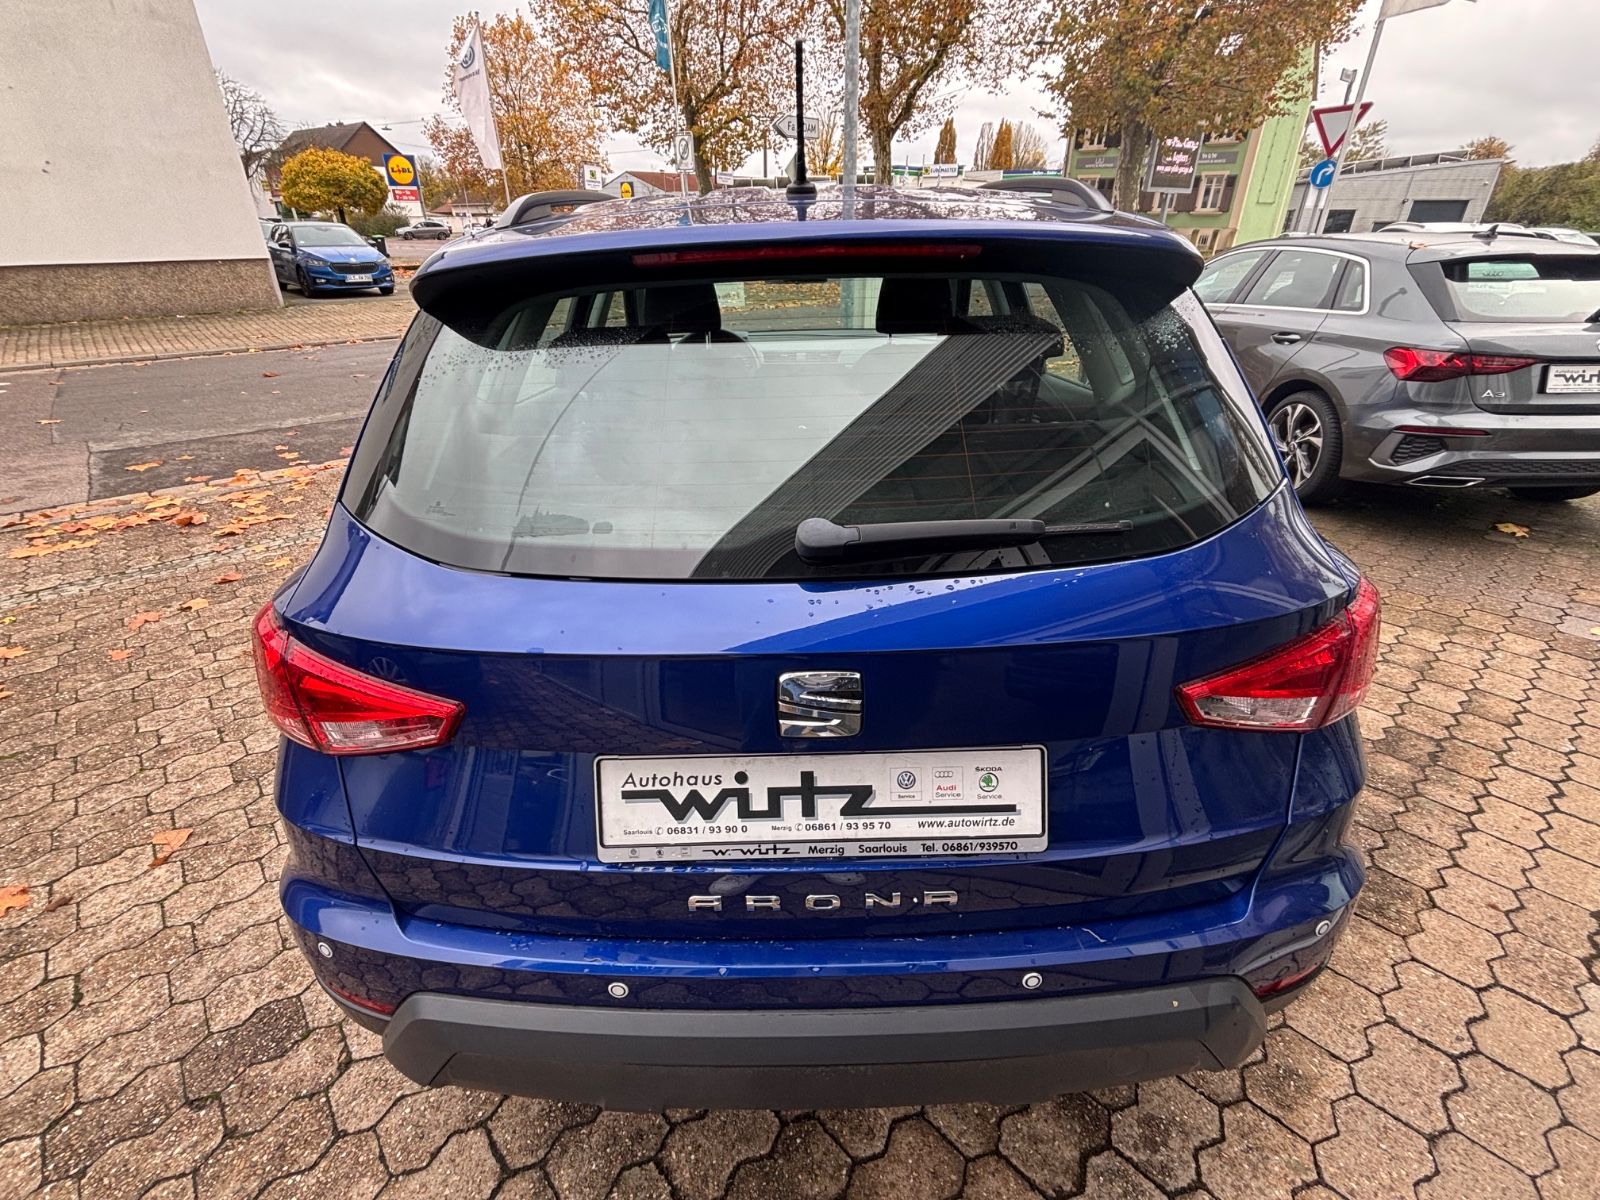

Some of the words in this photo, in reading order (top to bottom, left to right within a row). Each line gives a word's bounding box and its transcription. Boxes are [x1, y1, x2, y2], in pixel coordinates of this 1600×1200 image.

[1481, 389, 1506, 398] A3
[621, 771, 723, 788] Autohaus
[805, 823, 836, 831] 06861
[846, 822, 859, 830] 93
[862, 822, 875, 830] 95
[879, 821, 891, 830] 70
[917, 817, 1016, 829] www.autowirtz.de
[666, 826, 699, 835] 06831
[708, 825, 722, 834] 93
[724, 825, 738, 833] 90
[741, 825, 748, 833] 0
[807, 845, 845, 856] Merzig
[858, 843, 908, 853] Saarlouis
[921, 843, 939, 852] Tel.
[942, 841, 1018, 852] 06861/939570
